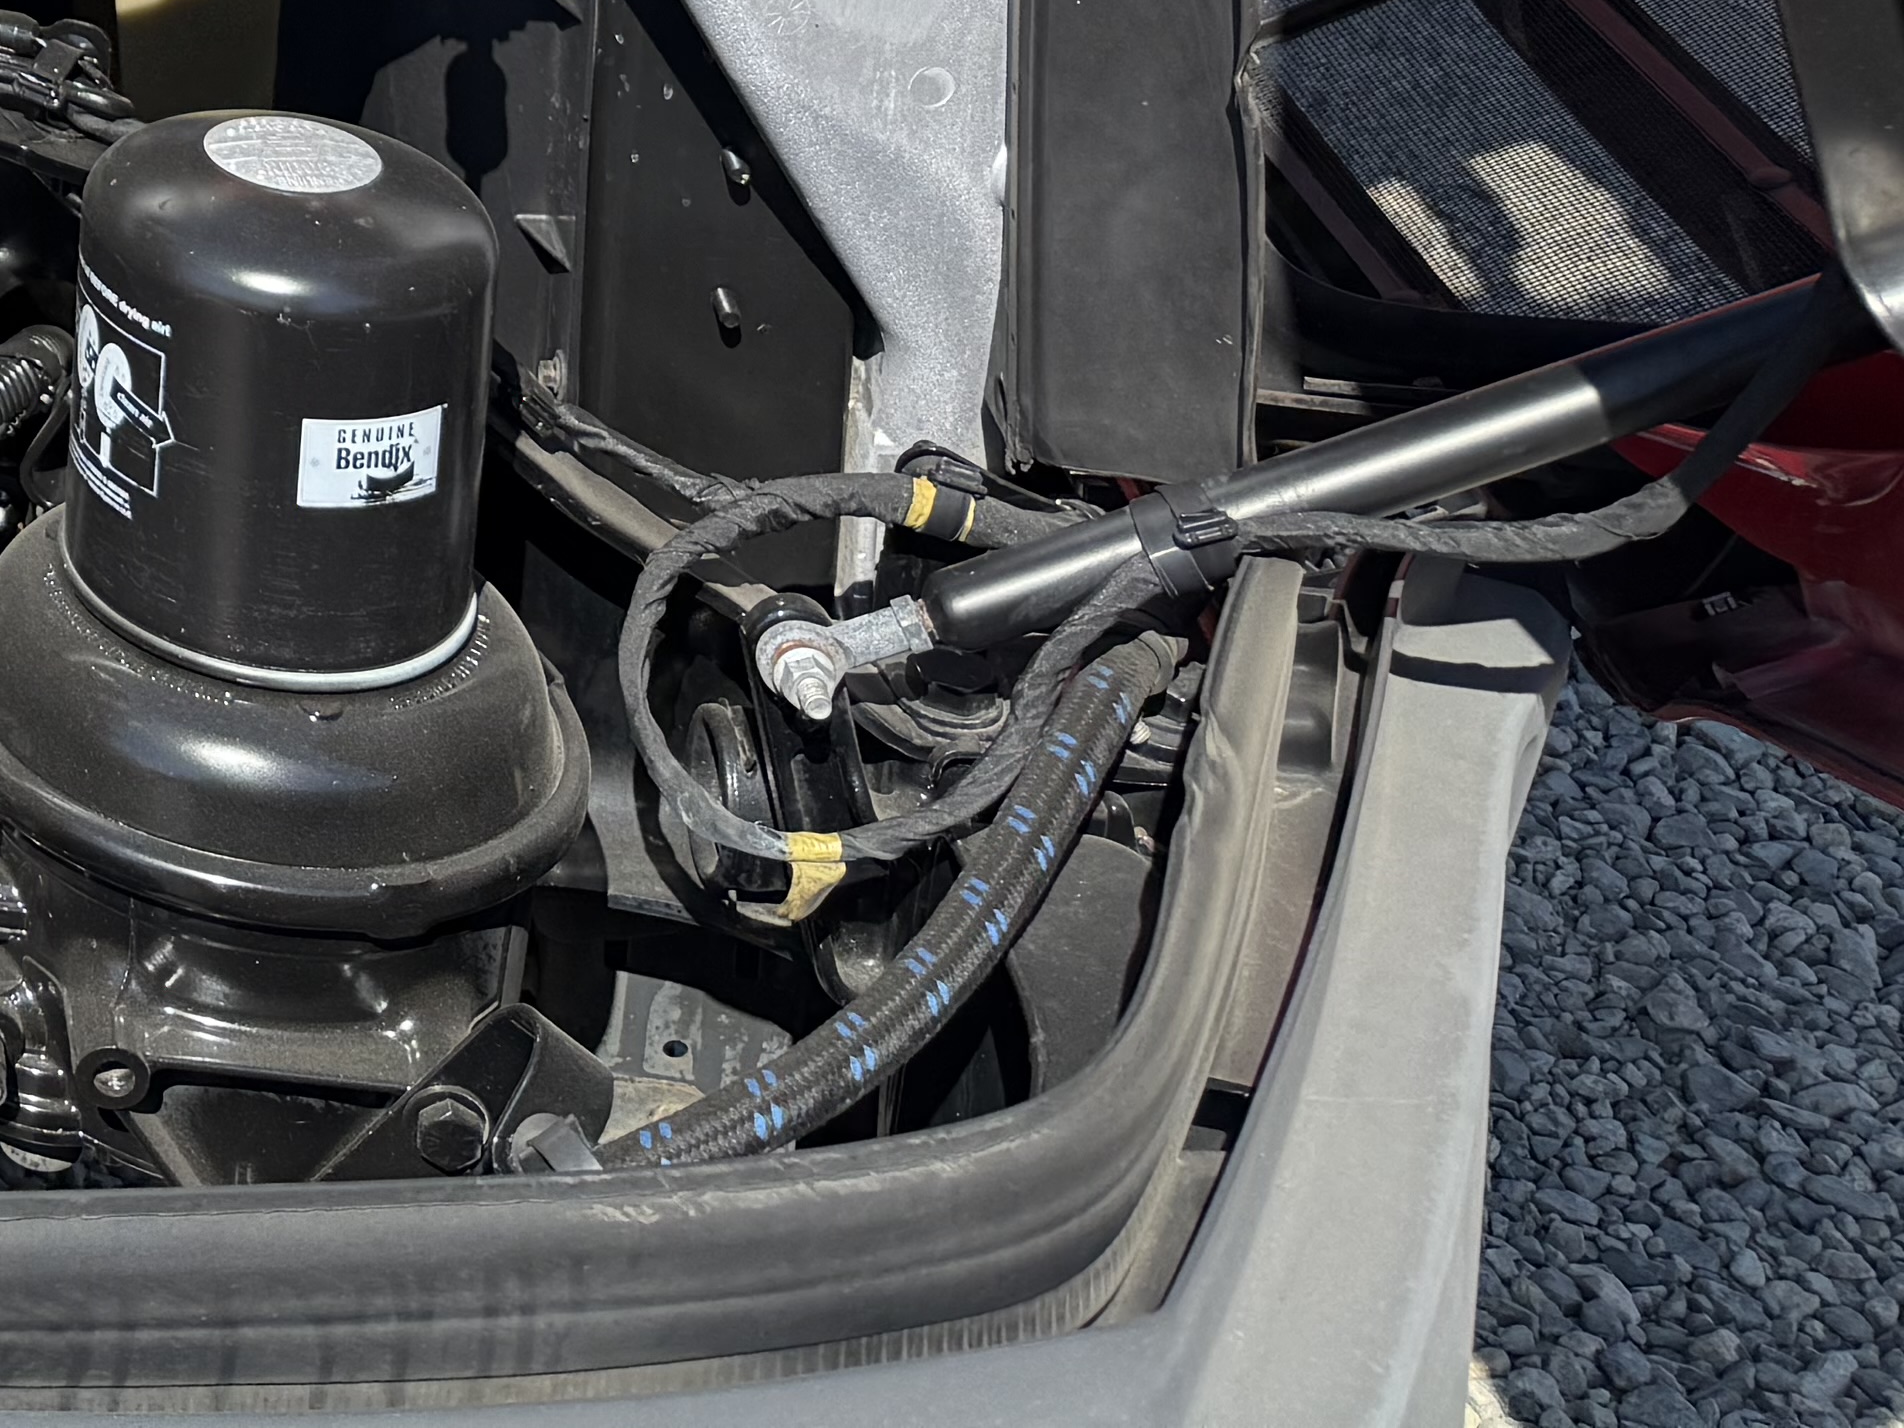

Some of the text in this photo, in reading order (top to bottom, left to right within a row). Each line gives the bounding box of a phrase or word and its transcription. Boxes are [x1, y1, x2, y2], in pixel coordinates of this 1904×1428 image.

[119, 300, 150, 331] drying
[337, 422, 415, 444] GENUINE
[336, 443, 412, 472] Bendix
